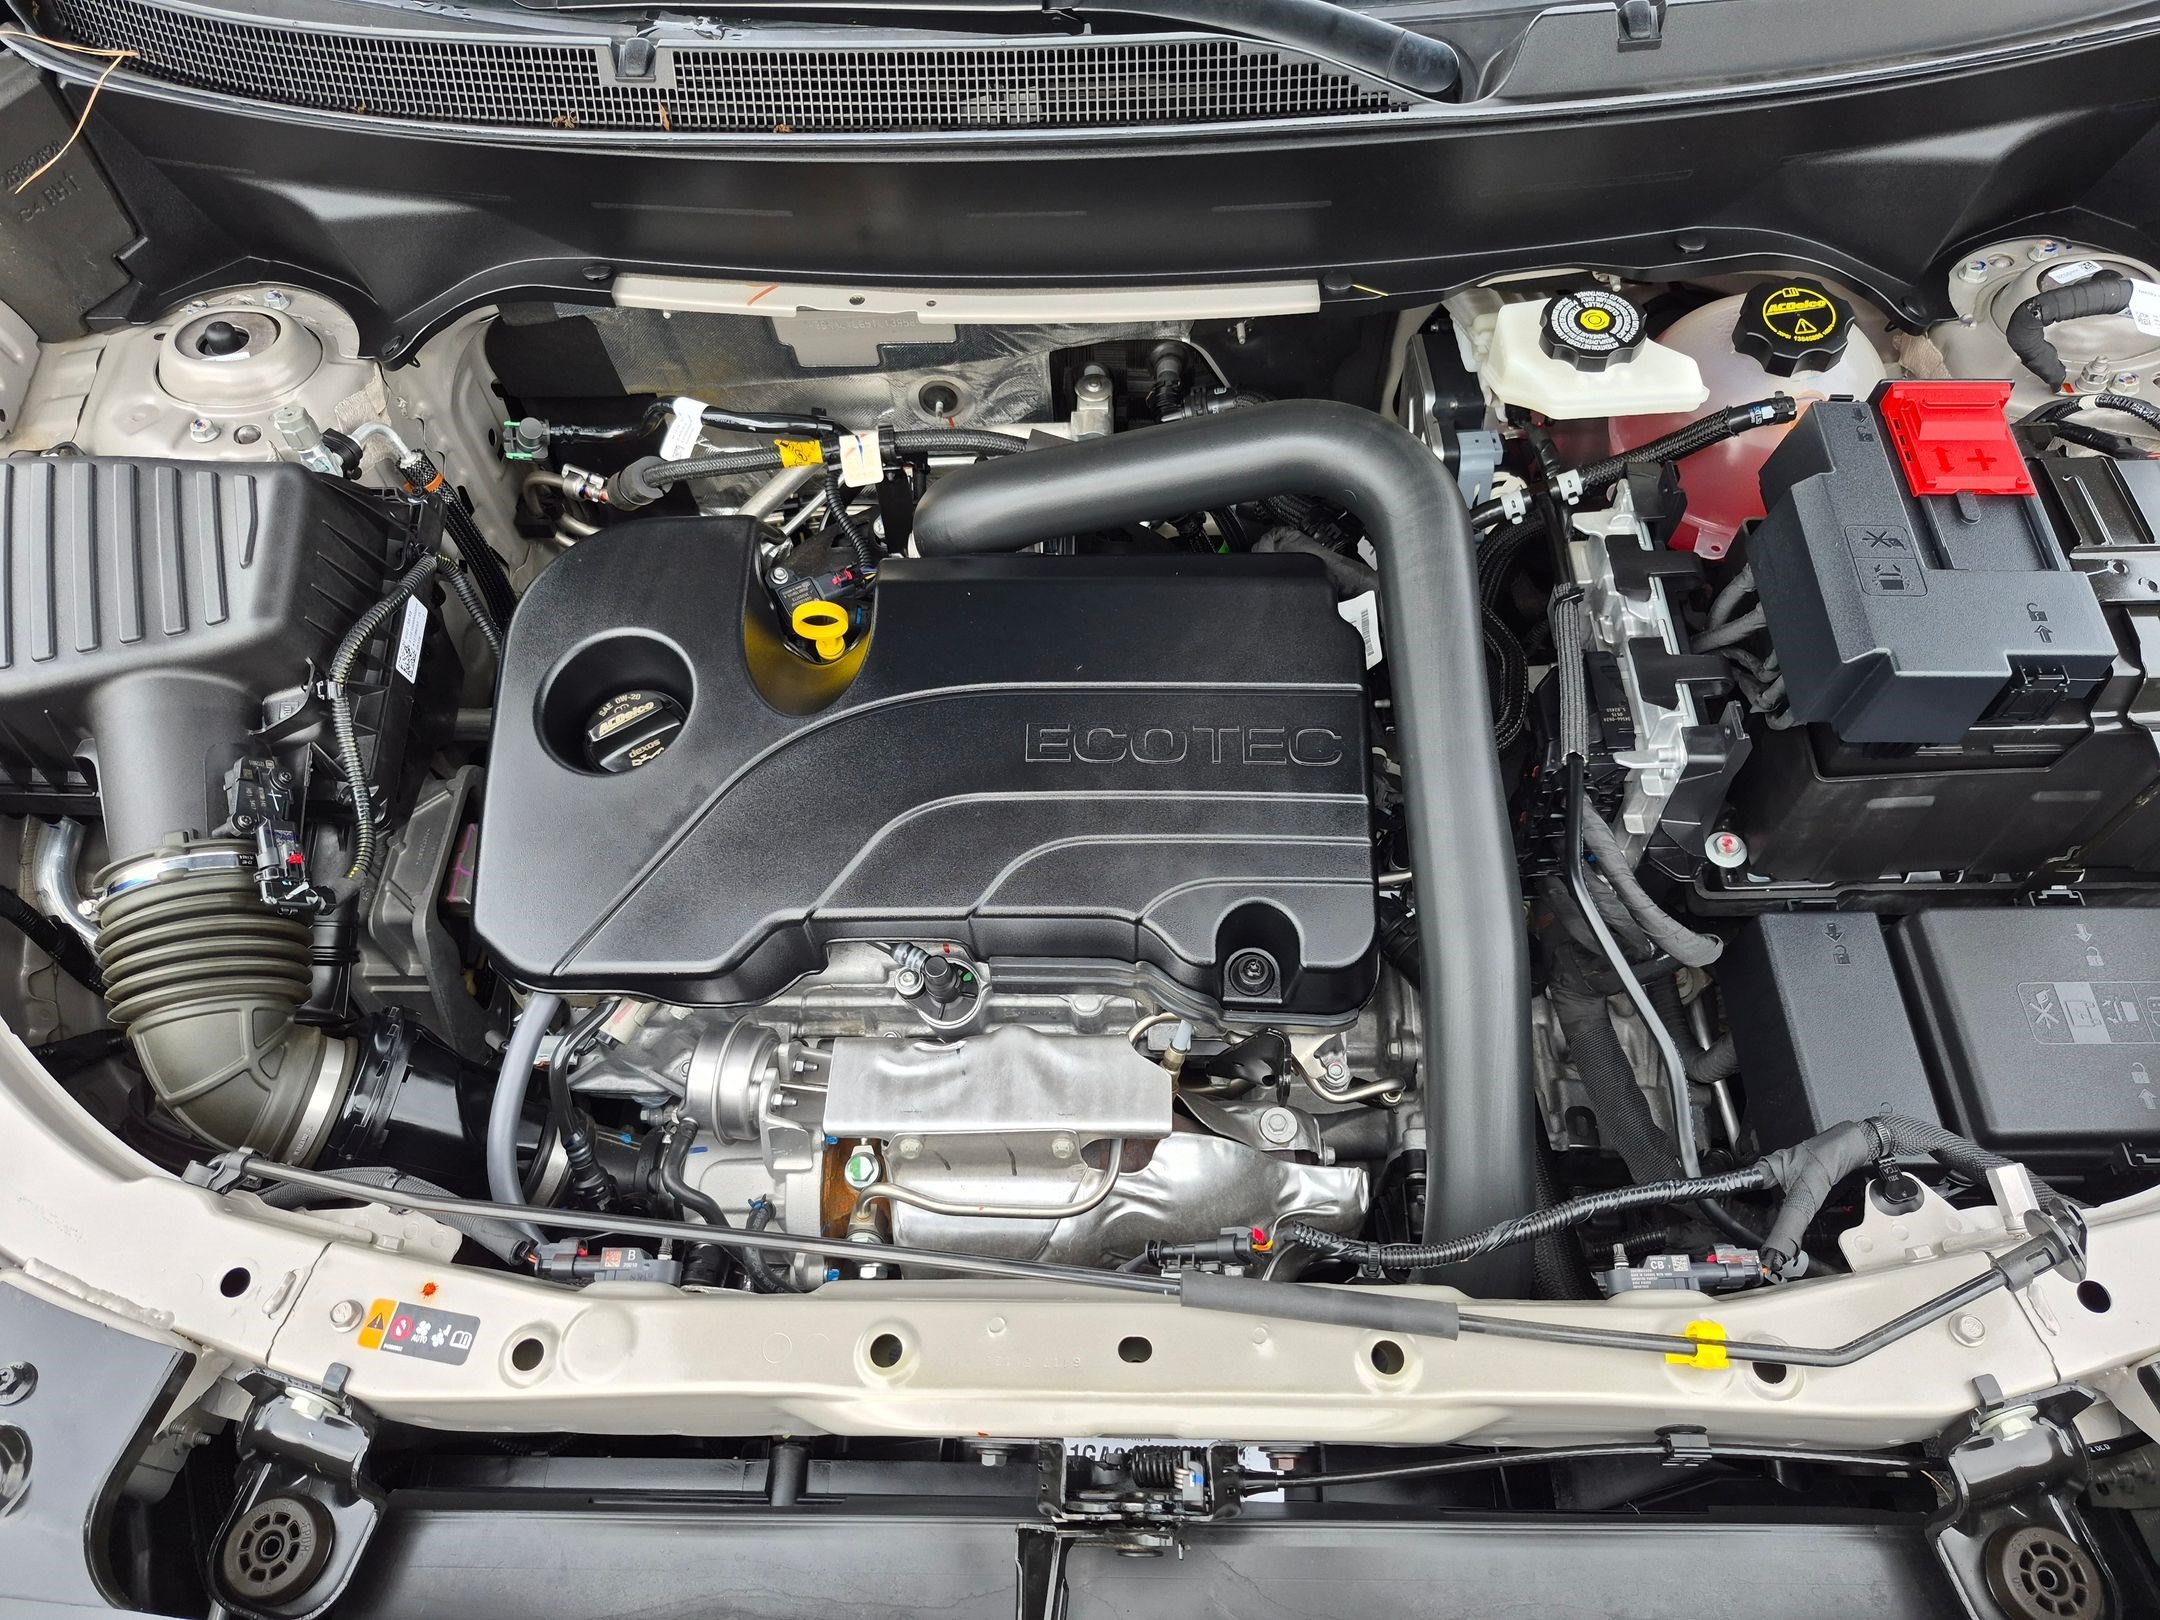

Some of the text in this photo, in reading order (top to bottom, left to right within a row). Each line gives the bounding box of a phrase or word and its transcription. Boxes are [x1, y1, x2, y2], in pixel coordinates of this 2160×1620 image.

[1767, 300, 1826, 314] ACDelco
[598, 702, 614, 717] SAE
[599, 701, 655, 736] ACDelco
[629, 739, 661, 758] dexos
[1025, 722, 1343, 767] ECOTEC
[627, 1249, 637, 1261] B
[1650, 1260, 1665, 1271] CB
[410, 1333, 429, 1345] AUTO
